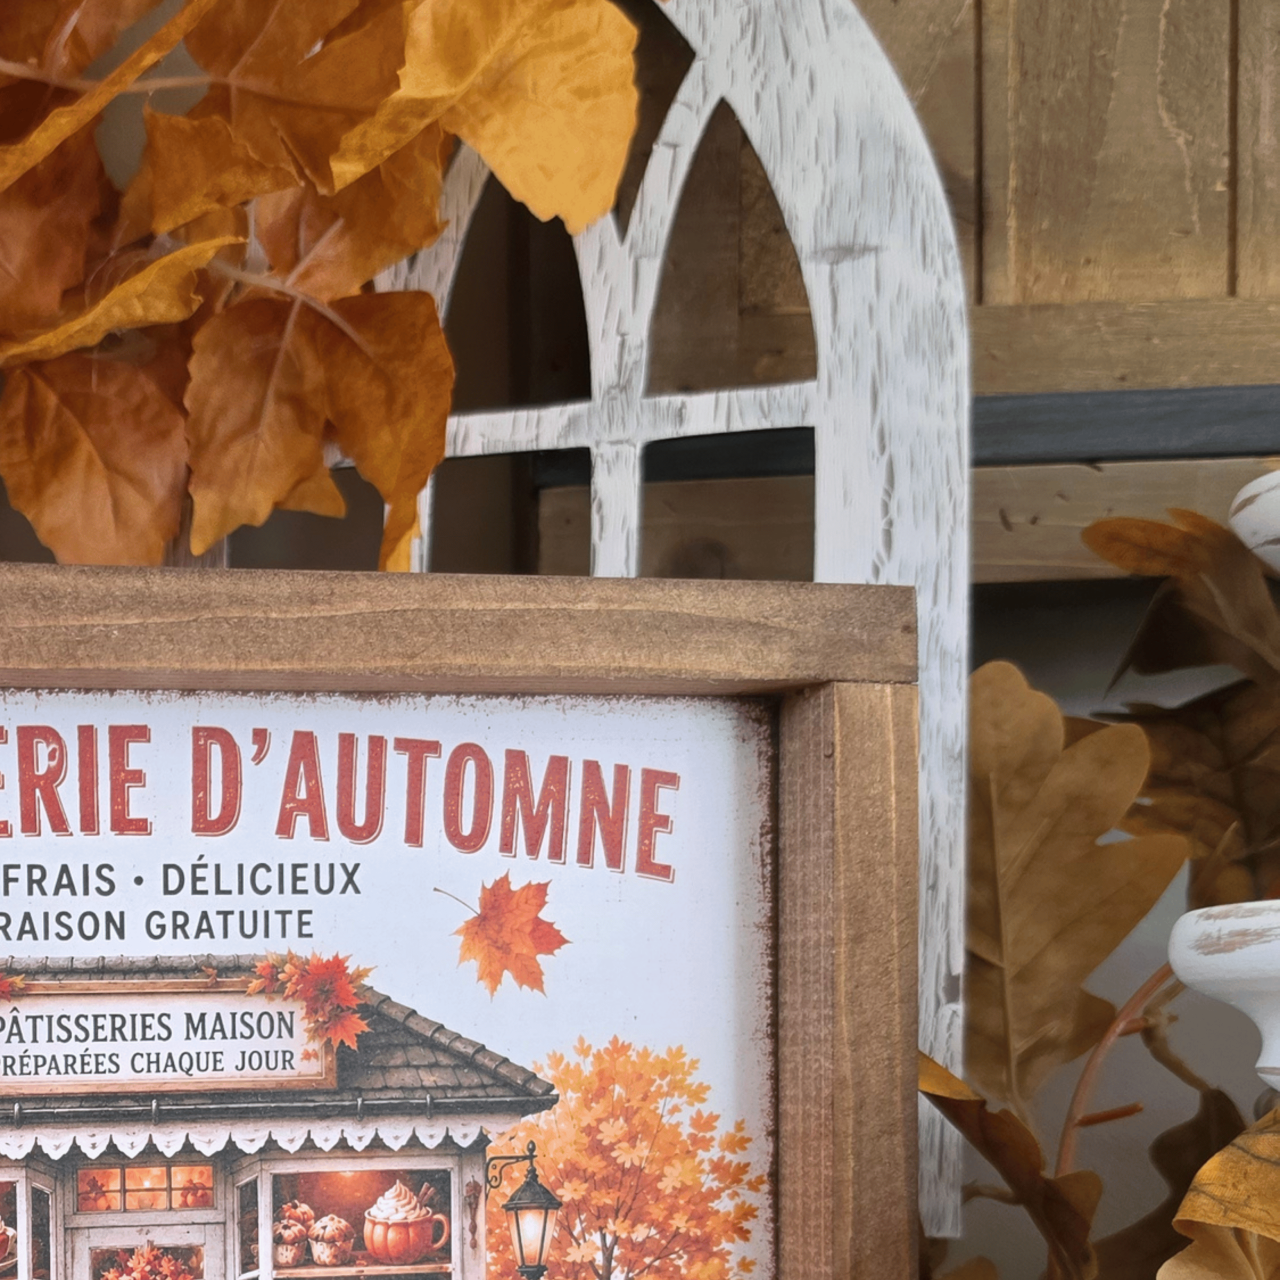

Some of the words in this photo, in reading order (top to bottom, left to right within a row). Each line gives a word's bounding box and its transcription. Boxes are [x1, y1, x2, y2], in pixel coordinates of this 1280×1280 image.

[191, 725, 681, 883] D’AUTOMNE
[2, 863, 117, 897] FRAIS
[161, 854, 362, 896] DÉLICIEUX
[145, 909, 314, 940] GRATUITE
[183, 1010, 296, 1041] MAISON
[129, 1051, 225, 1077] CHAQUE
[234, 1050, 296, 1072] JOUR
